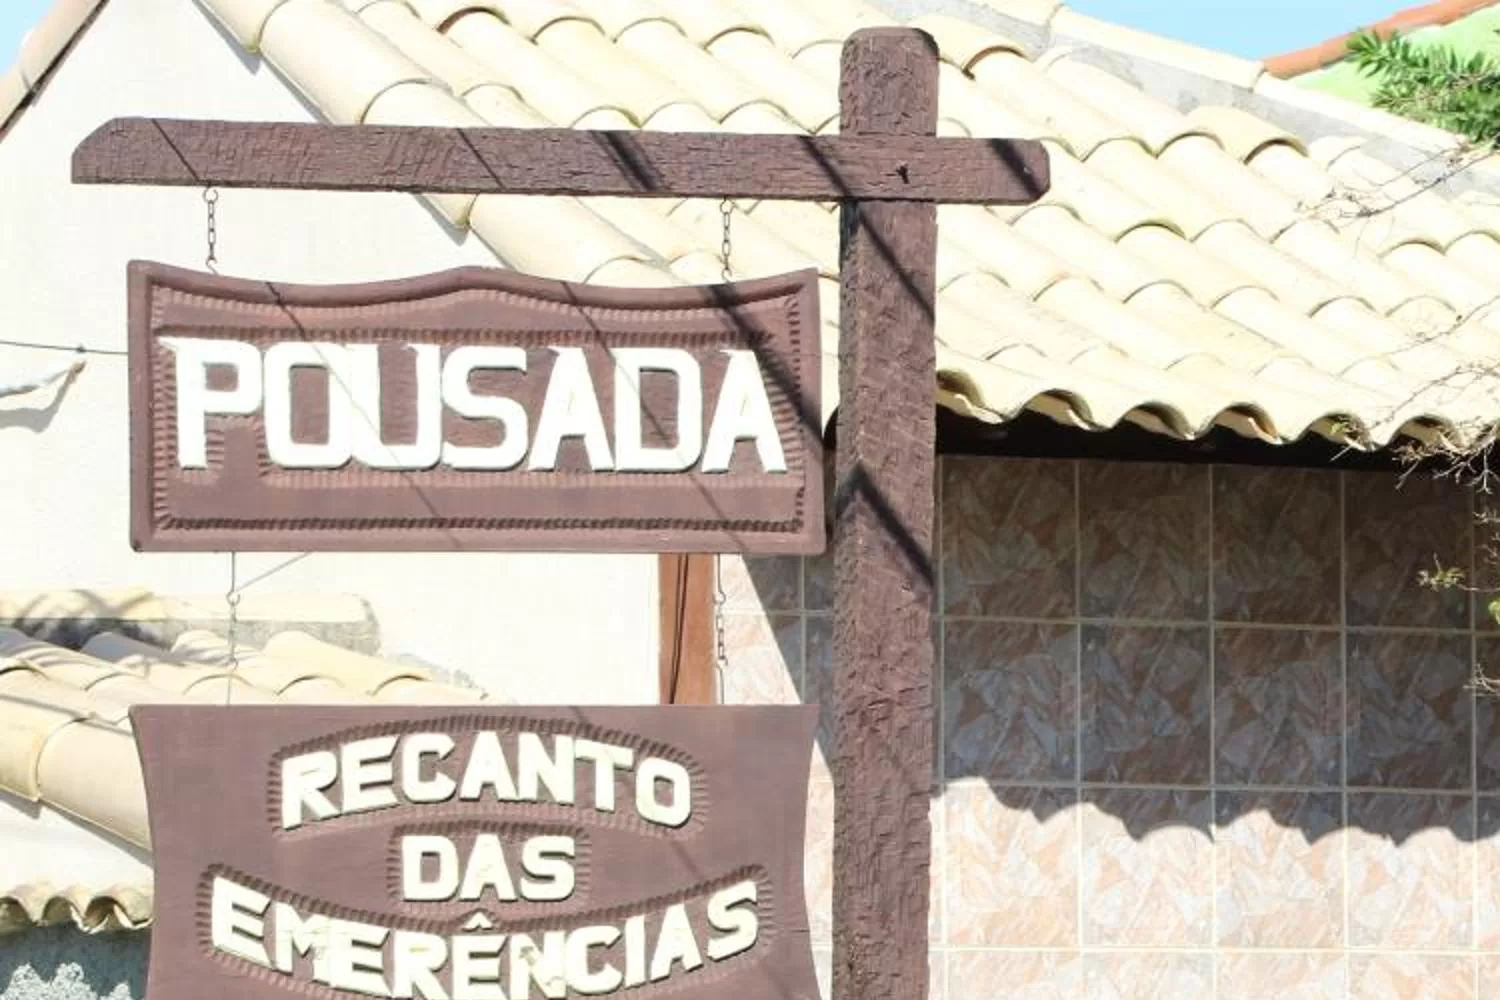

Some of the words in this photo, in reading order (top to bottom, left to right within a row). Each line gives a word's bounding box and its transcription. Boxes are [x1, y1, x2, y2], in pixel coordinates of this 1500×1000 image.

[158, 336, 788, 474] POUSADA
[280, 730, 692, 829] RECANTO
[400, 833, 575, 902] DAS
